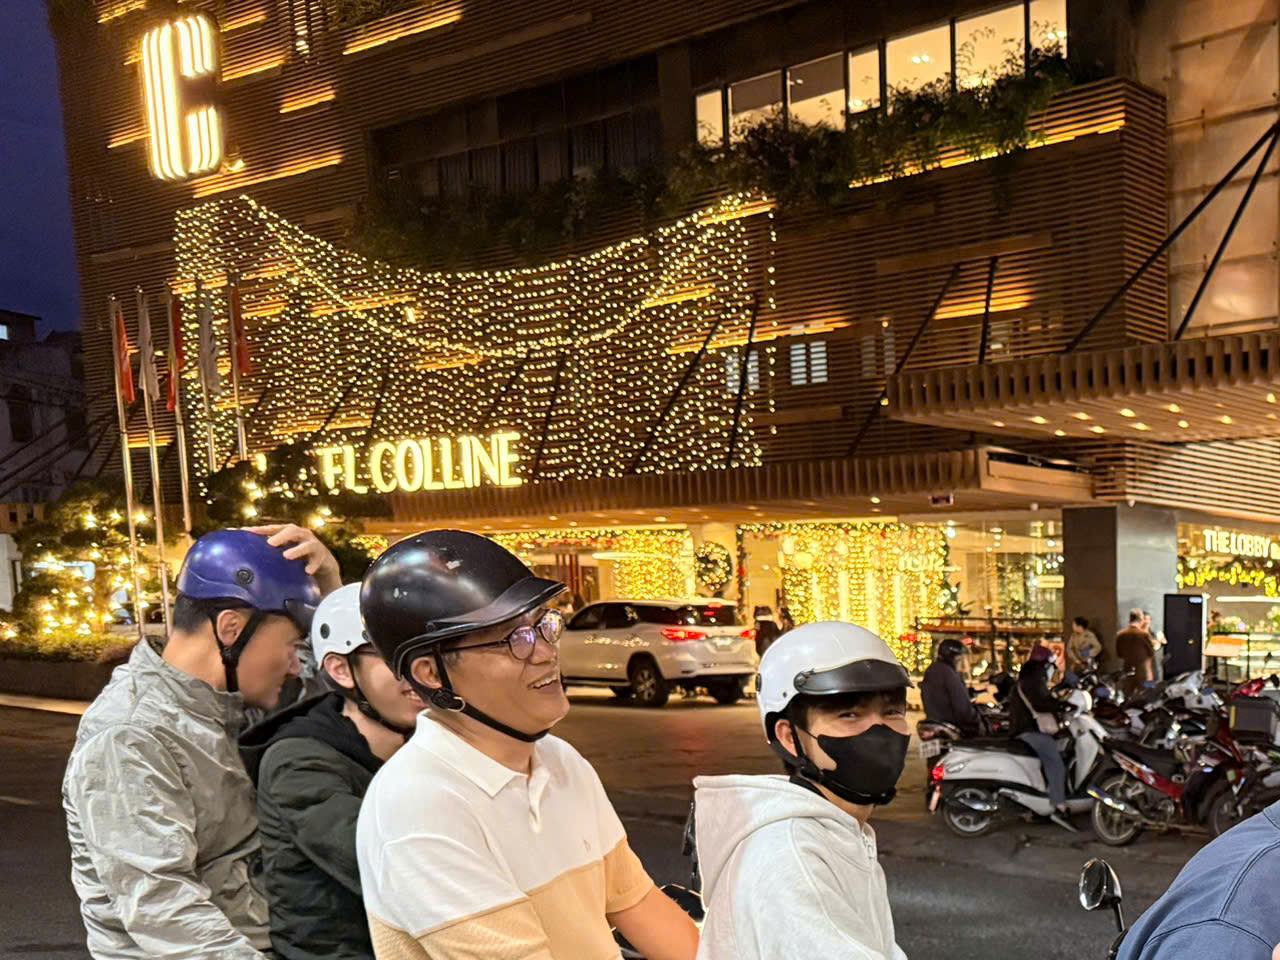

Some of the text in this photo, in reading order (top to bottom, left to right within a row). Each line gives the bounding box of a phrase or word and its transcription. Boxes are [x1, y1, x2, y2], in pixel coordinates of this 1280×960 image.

[370, 431, 522, 493] COLLINE
[1203, 529, 1230, 553] THE
[1231, 533, 1270, 558] LOBBY
